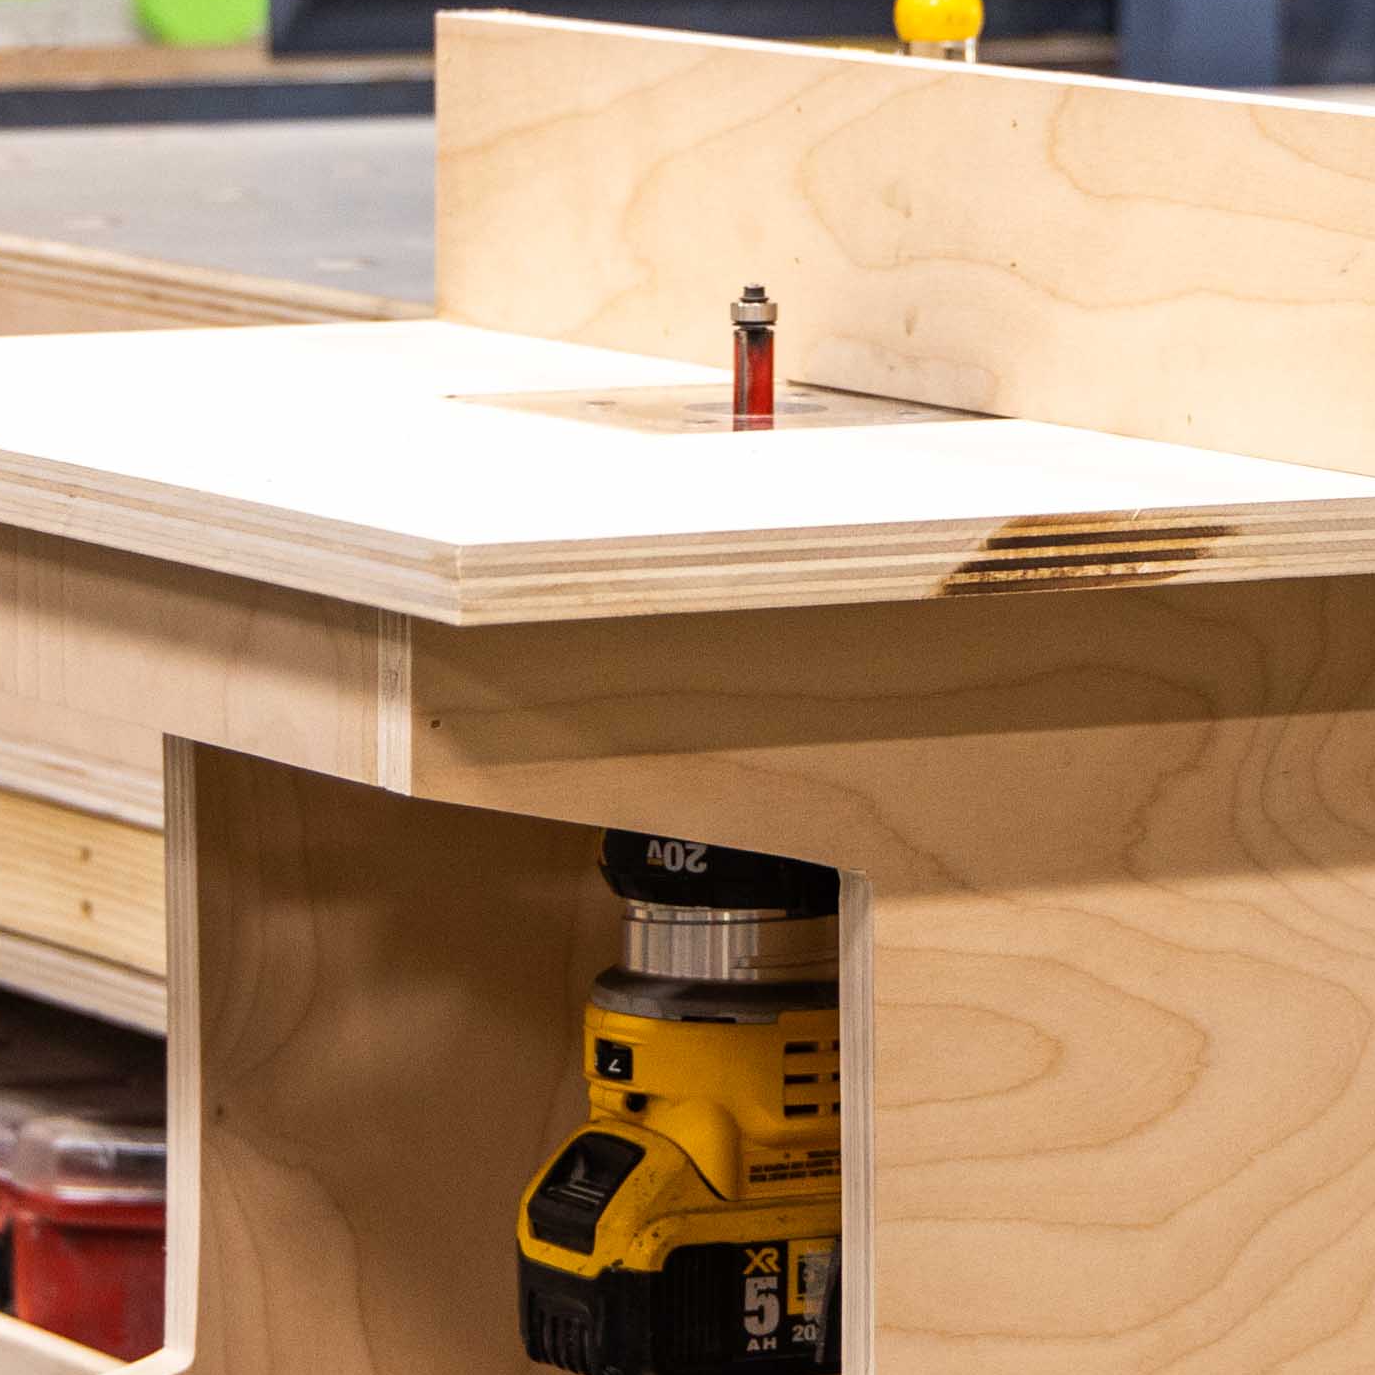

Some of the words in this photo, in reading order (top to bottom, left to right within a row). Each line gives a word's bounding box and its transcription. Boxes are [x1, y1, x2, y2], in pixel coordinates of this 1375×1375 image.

[743, 1247, 782, 1275] XR
[743, 1276, 780, 1337] 5
[745, 1337, 778, 1352] AH
